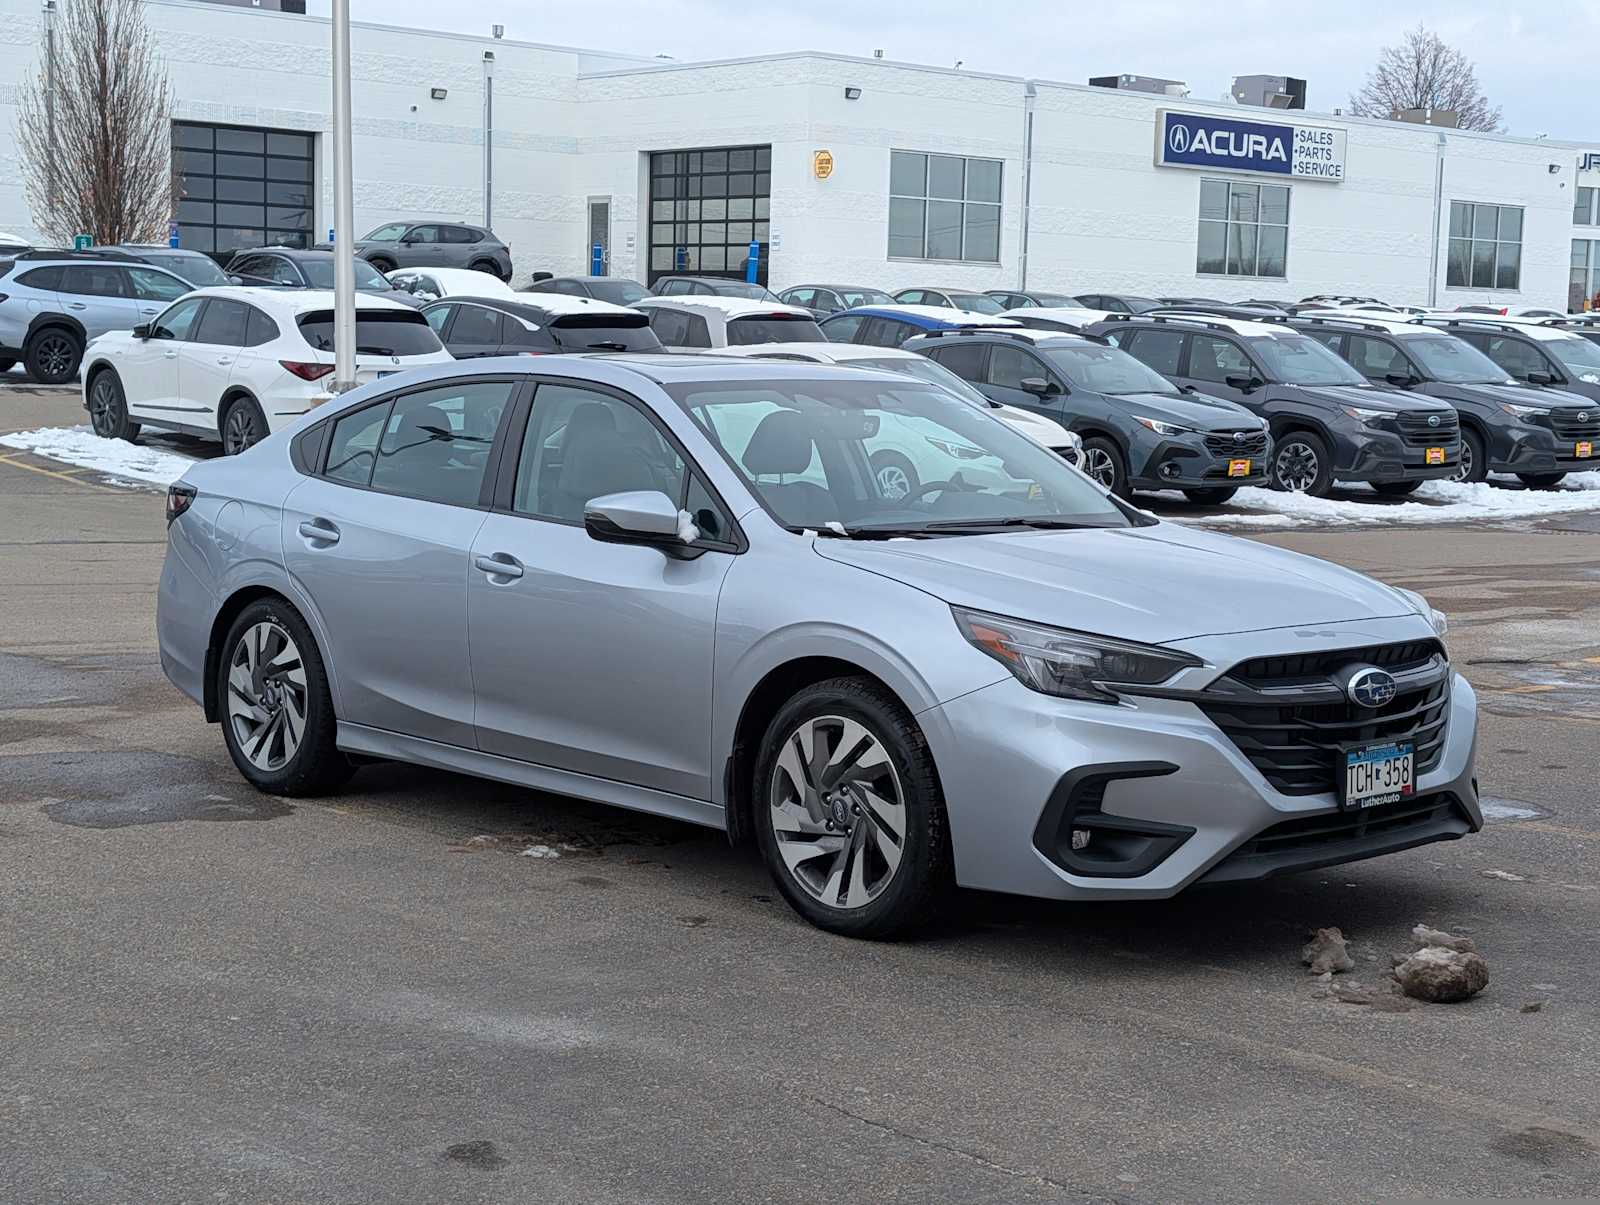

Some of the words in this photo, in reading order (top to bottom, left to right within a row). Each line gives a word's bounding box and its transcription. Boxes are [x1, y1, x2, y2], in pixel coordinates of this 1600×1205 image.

[1189, 129, 1287, 162] ACURA
[1299, 130, 1333, 145] SALES
[1298, 146, 1332, 161] PARTS
[1297, 161, 1341, 177] SERVICE
[1348, 761, 1373, 795] TCH
[1384, 756, 1410, 788] 358
